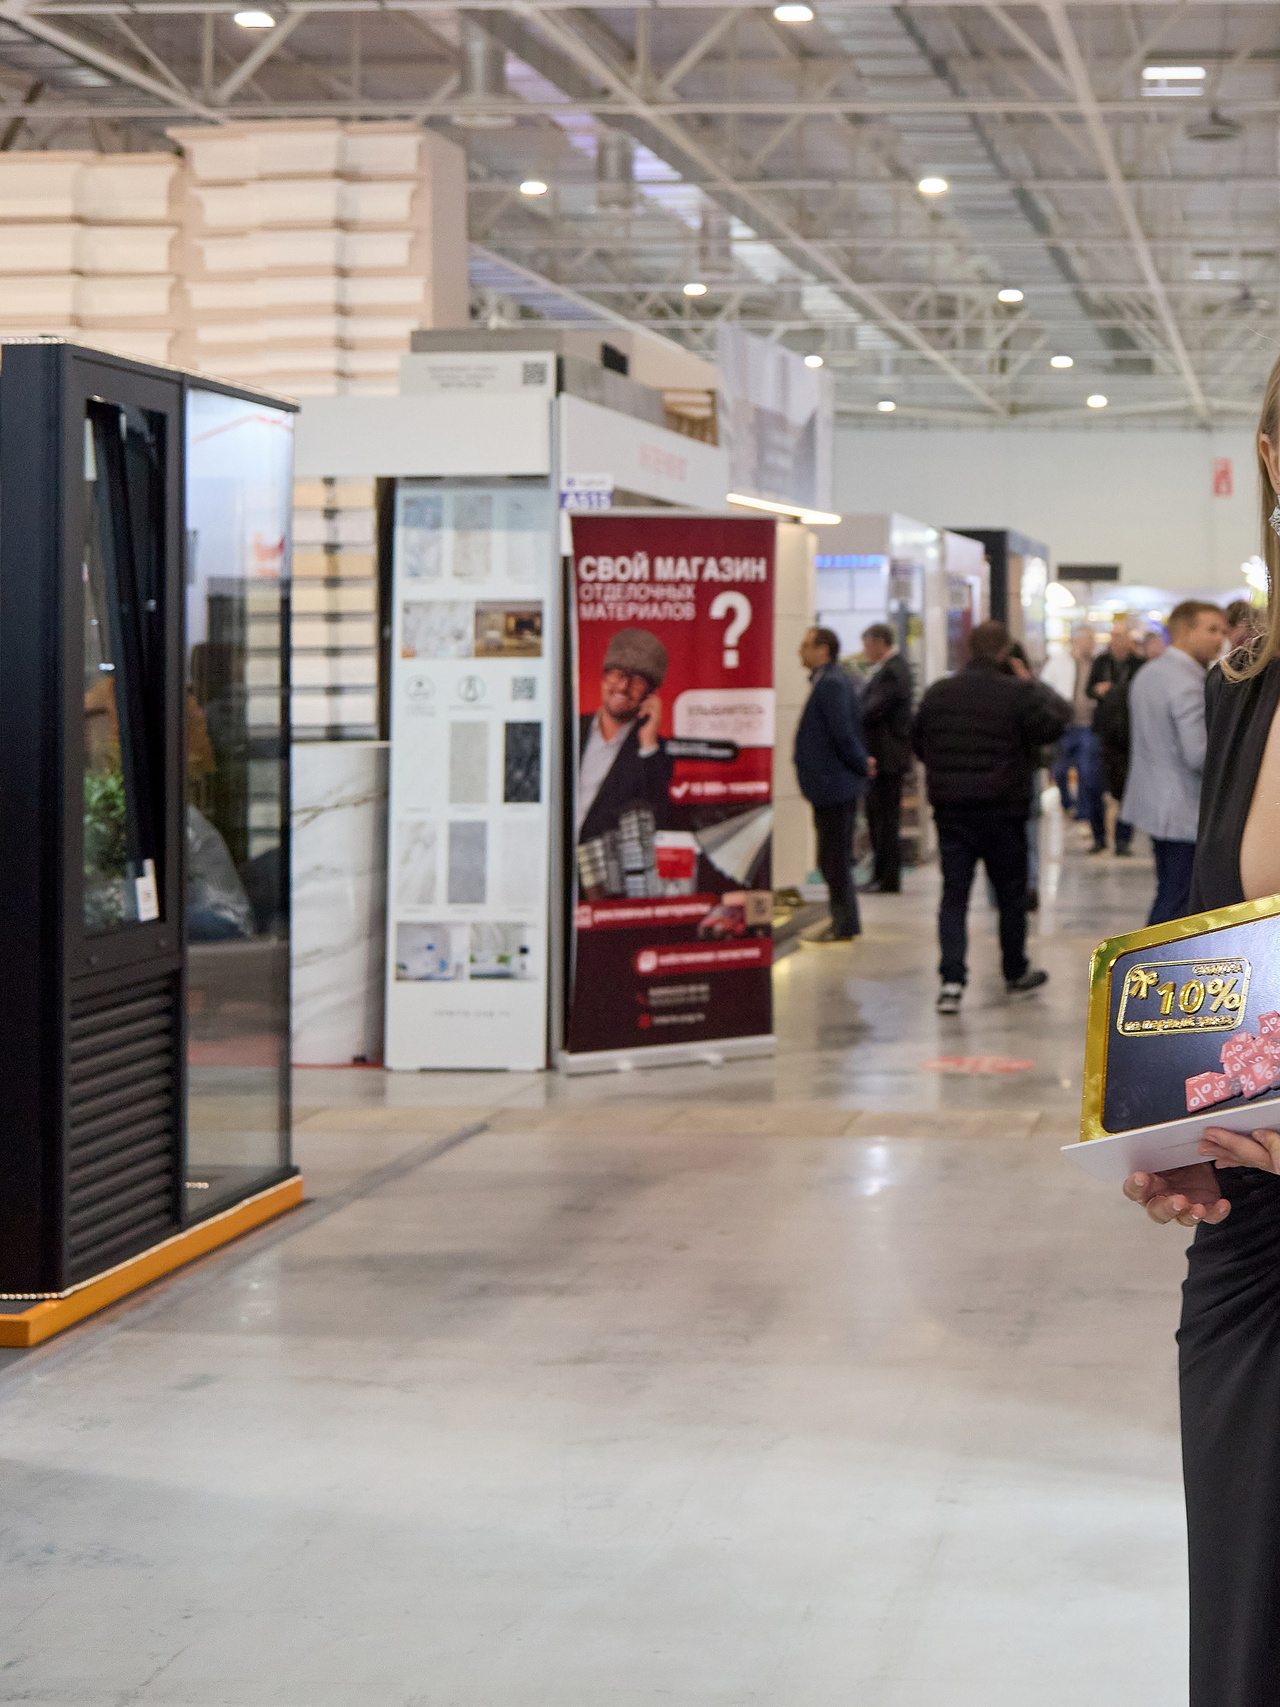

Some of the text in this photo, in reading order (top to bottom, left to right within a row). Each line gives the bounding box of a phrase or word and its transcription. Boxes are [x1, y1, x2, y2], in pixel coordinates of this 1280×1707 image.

[578, 552, 768, 583] СВОЙ МАГАЗИН
[579, 583, 696, 602] ОТДЕЛОЧНЫХ
[580, 602, 697, 621] МАТЕРИАЛОВ
[709, 590, 752, 669] ?
[1156, 976, 1242, 1015] 10%
